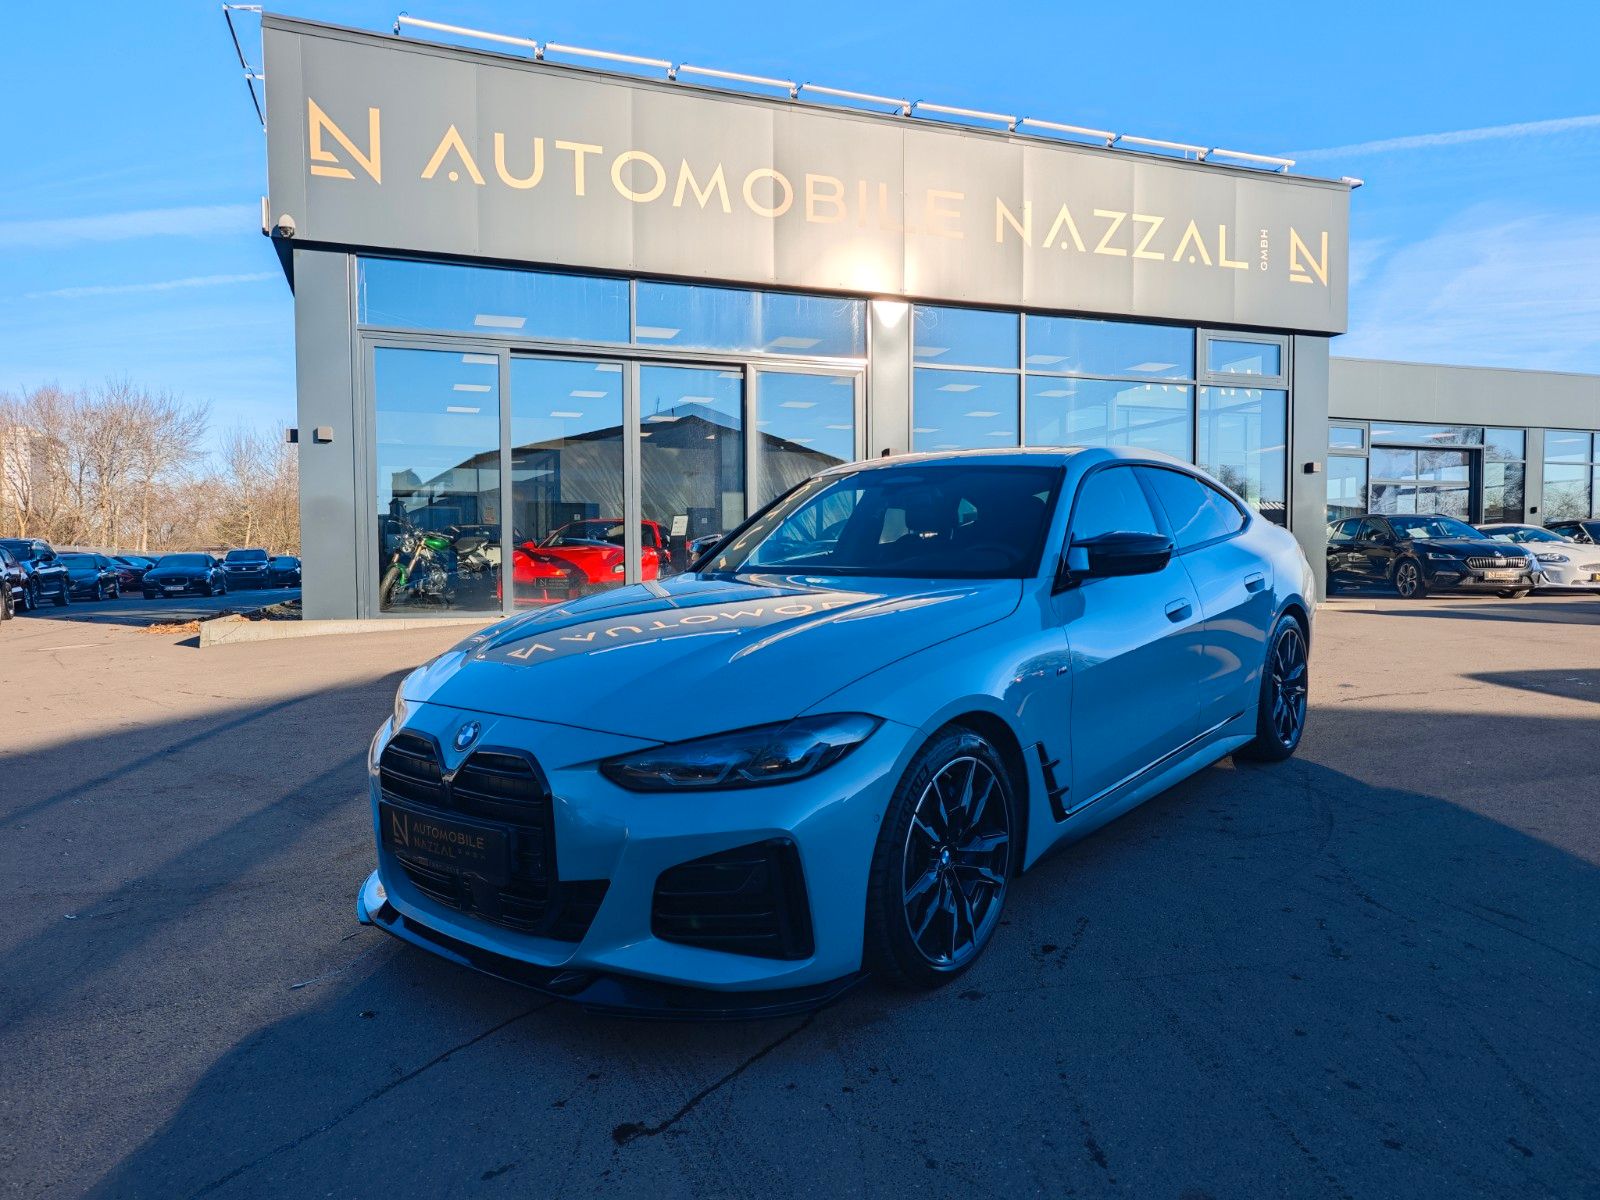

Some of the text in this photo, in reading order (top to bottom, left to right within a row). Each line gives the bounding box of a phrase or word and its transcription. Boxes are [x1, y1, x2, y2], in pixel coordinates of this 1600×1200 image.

[421, 124, 965, 240] AUTOMOBILE
[995, 196, 1249, 270] NAZZAL
[1260, 229, 1269, 271] GMBH
[413, 822, 485, 848] AUTOMOBILE
